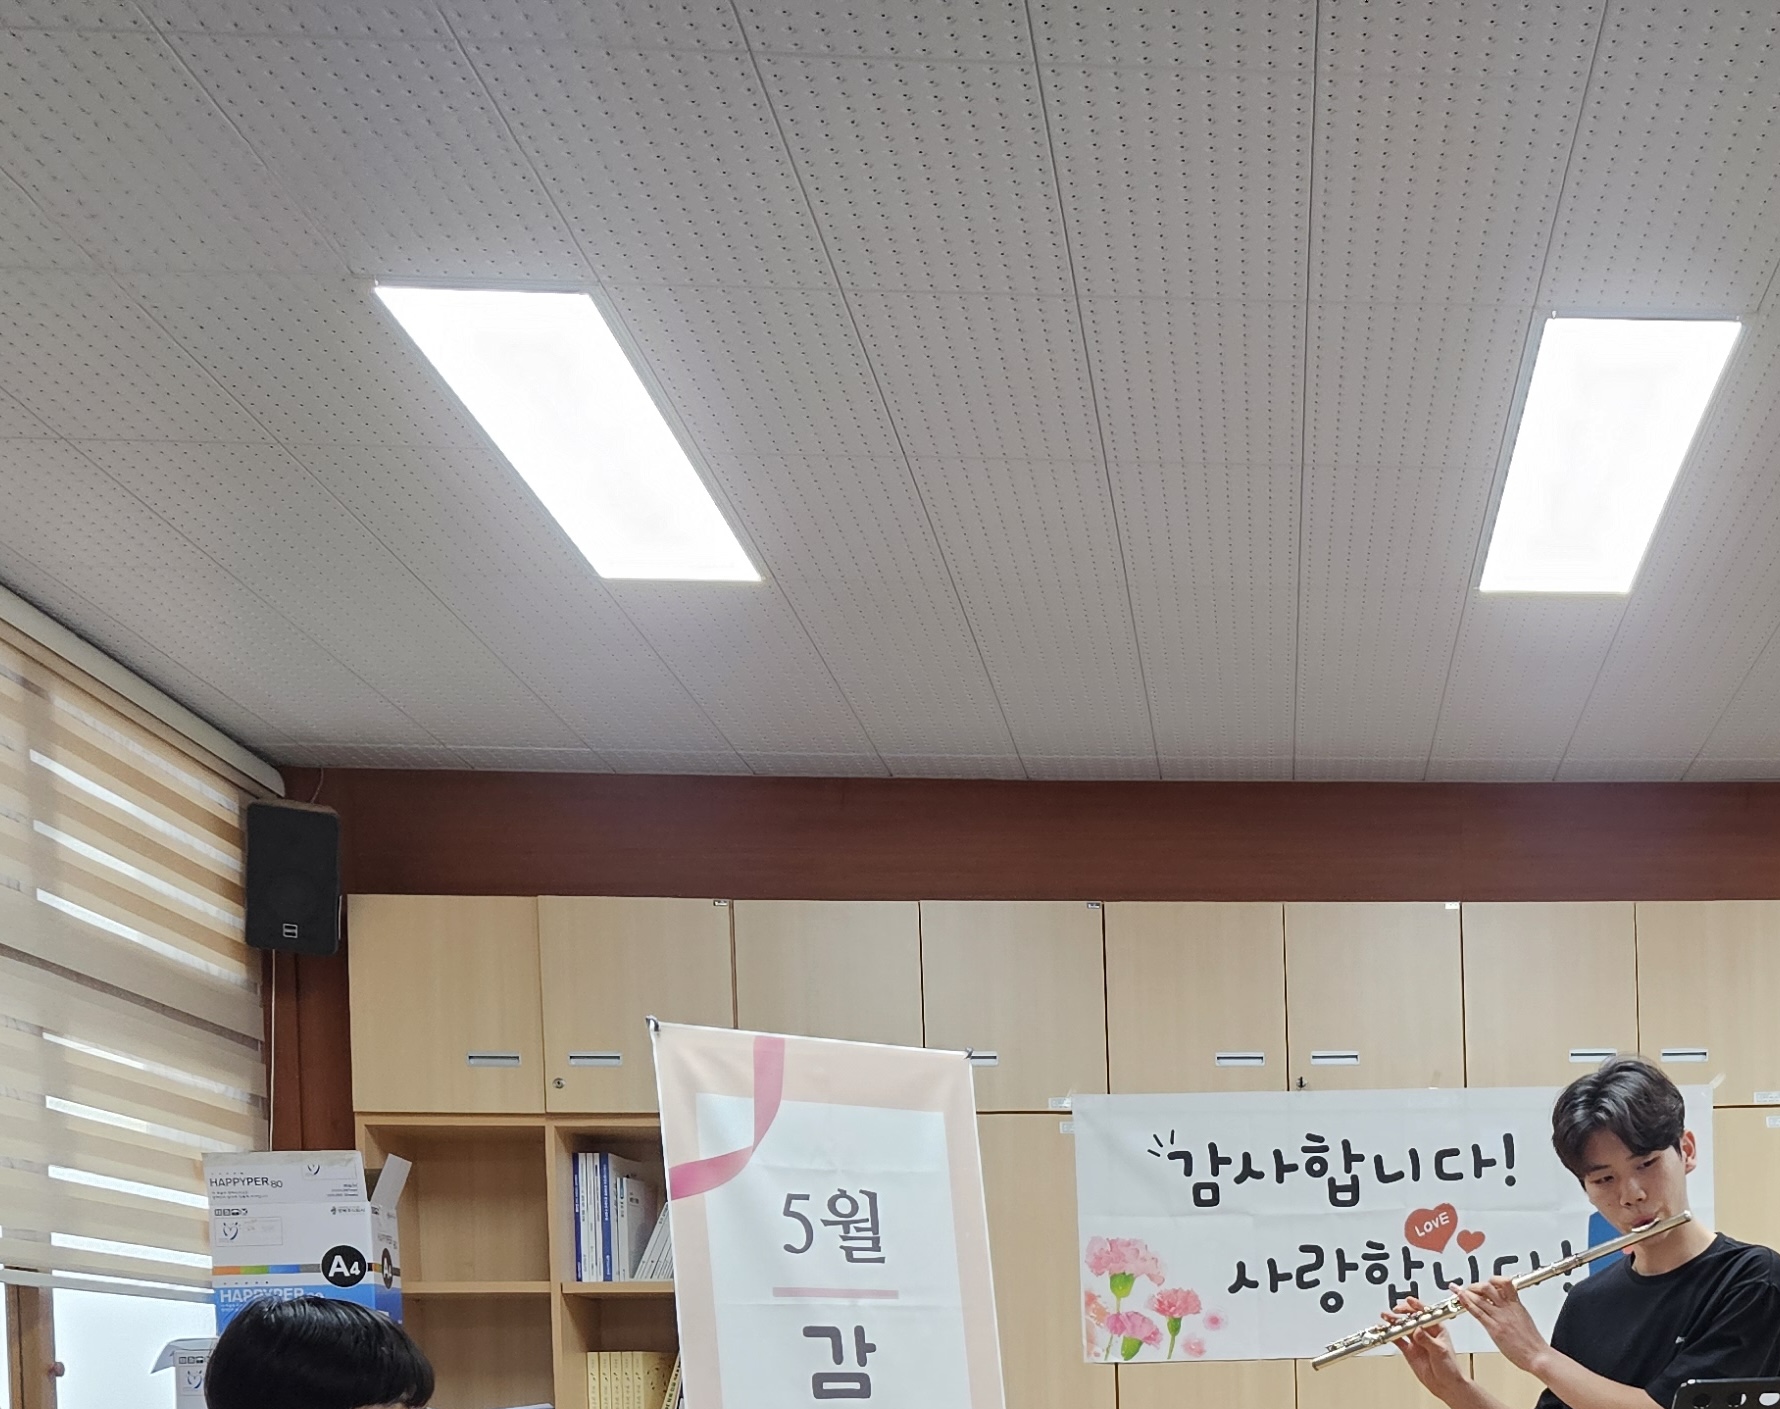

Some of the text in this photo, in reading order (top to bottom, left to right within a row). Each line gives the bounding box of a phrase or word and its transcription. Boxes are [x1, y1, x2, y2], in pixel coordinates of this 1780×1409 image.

[210, 1177, 283, 1188] HAPPYPER 80
[1167, 1133, 1517, 1207] 감사합니다!
[783, 1188, 886, 1264] 5월
[1414, 1211, 1450, 1237] LOVE
[328, 1255, 361, 1277] A4
